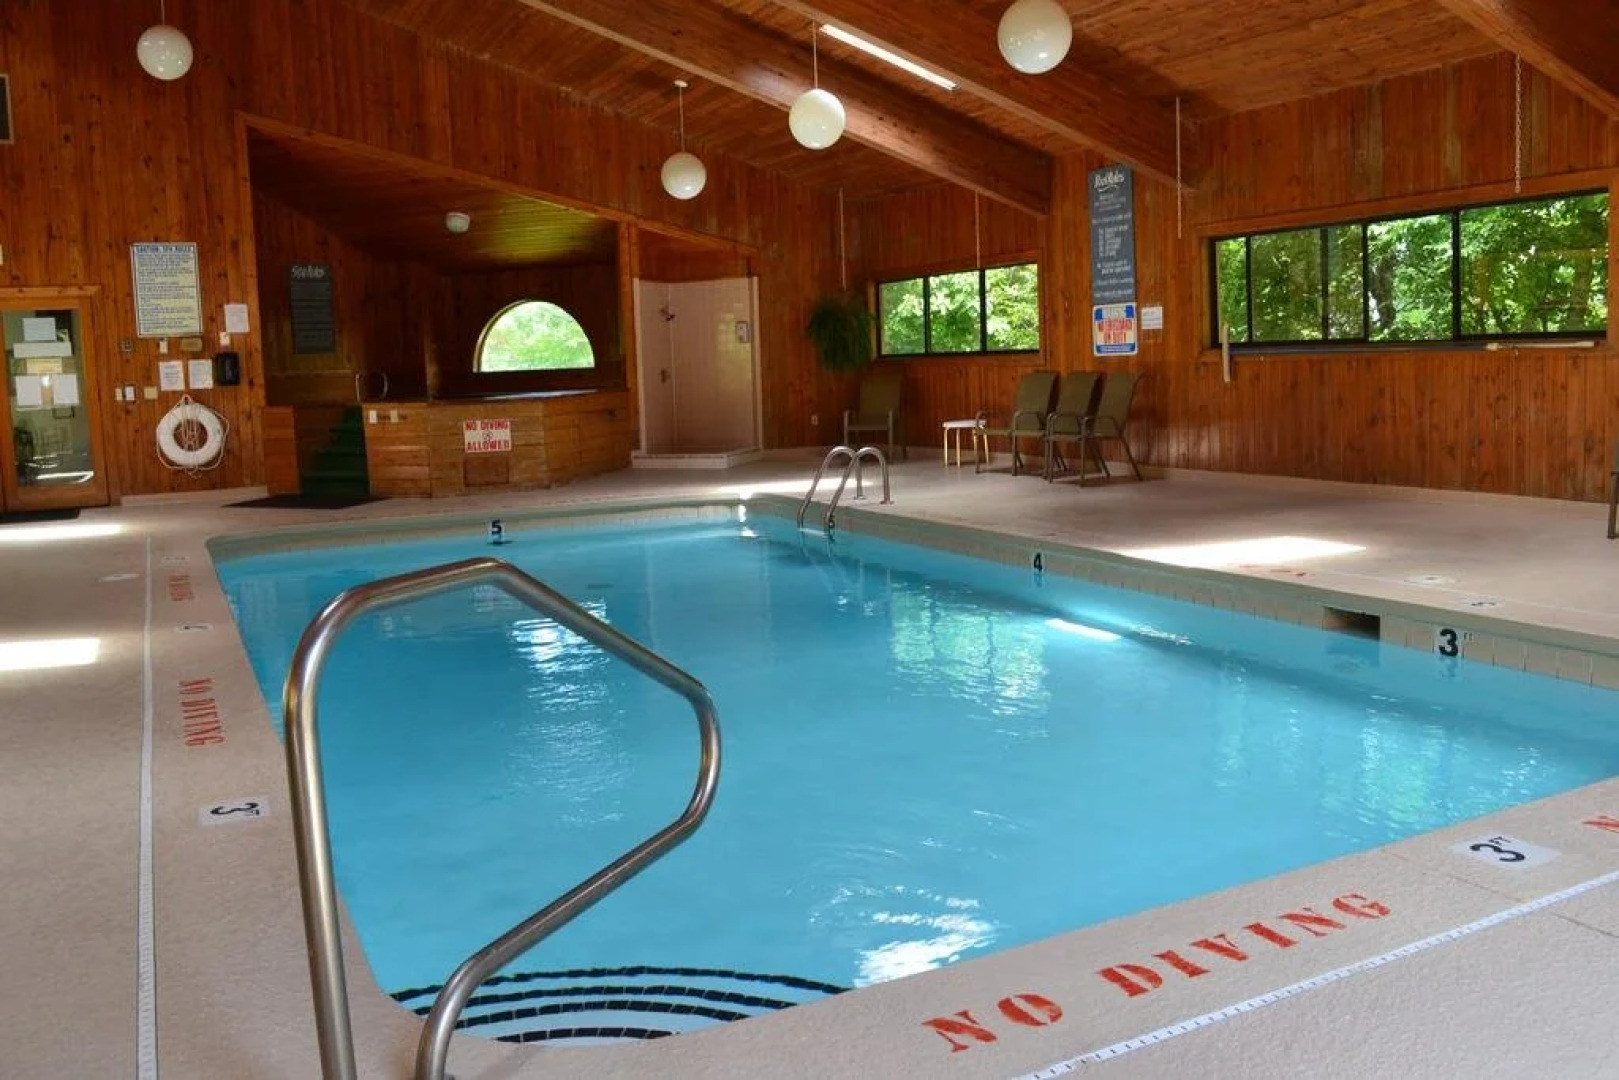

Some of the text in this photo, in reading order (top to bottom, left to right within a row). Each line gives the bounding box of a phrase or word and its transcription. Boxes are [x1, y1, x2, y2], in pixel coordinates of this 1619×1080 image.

[466, 419, 508, 431] NO DIVING
[467, 440, 510, 452] ALLOWED
[491, 519, 502, 535] 5
[1033, 552, 1043, 572] 4
[1438, 628, 1459, 657] 3
[181, 698, 226, 747] DIVING
[921, 894, 1391, 1053] NO DIVING
